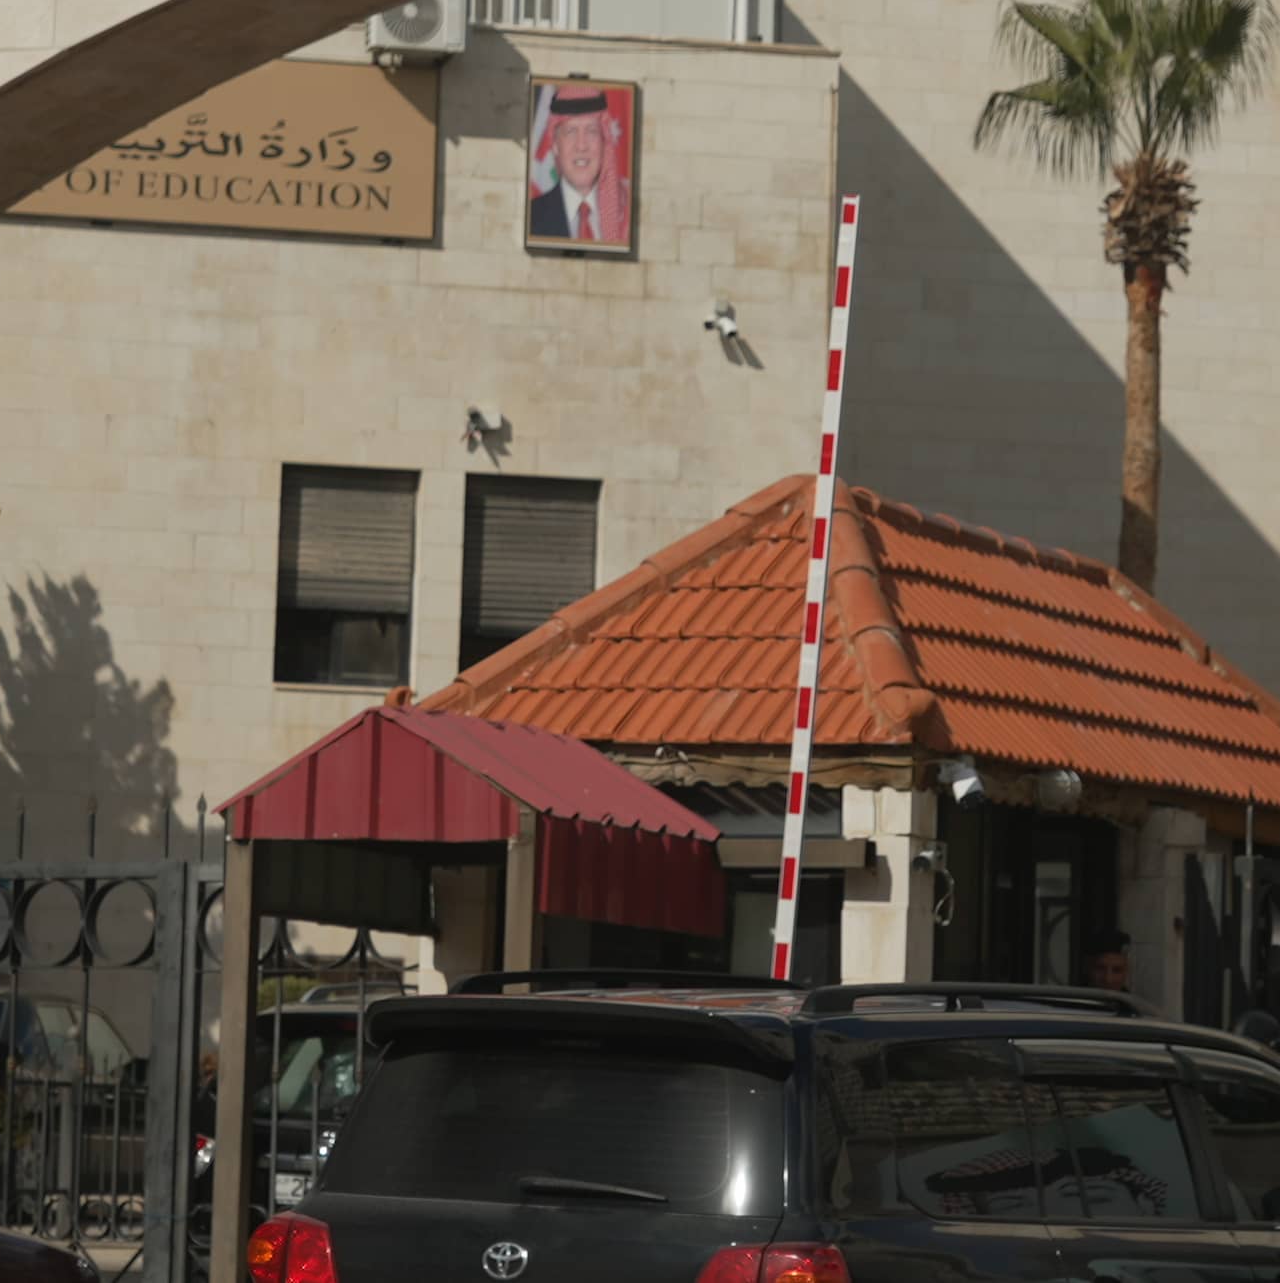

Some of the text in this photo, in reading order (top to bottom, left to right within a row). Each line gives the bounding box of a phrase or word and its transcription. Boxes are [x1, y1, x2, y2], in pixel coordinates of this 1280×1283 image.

[111, 112, 392, 173] وزارة التربي
[65, 167, 392, 212] OF EDUCATION
